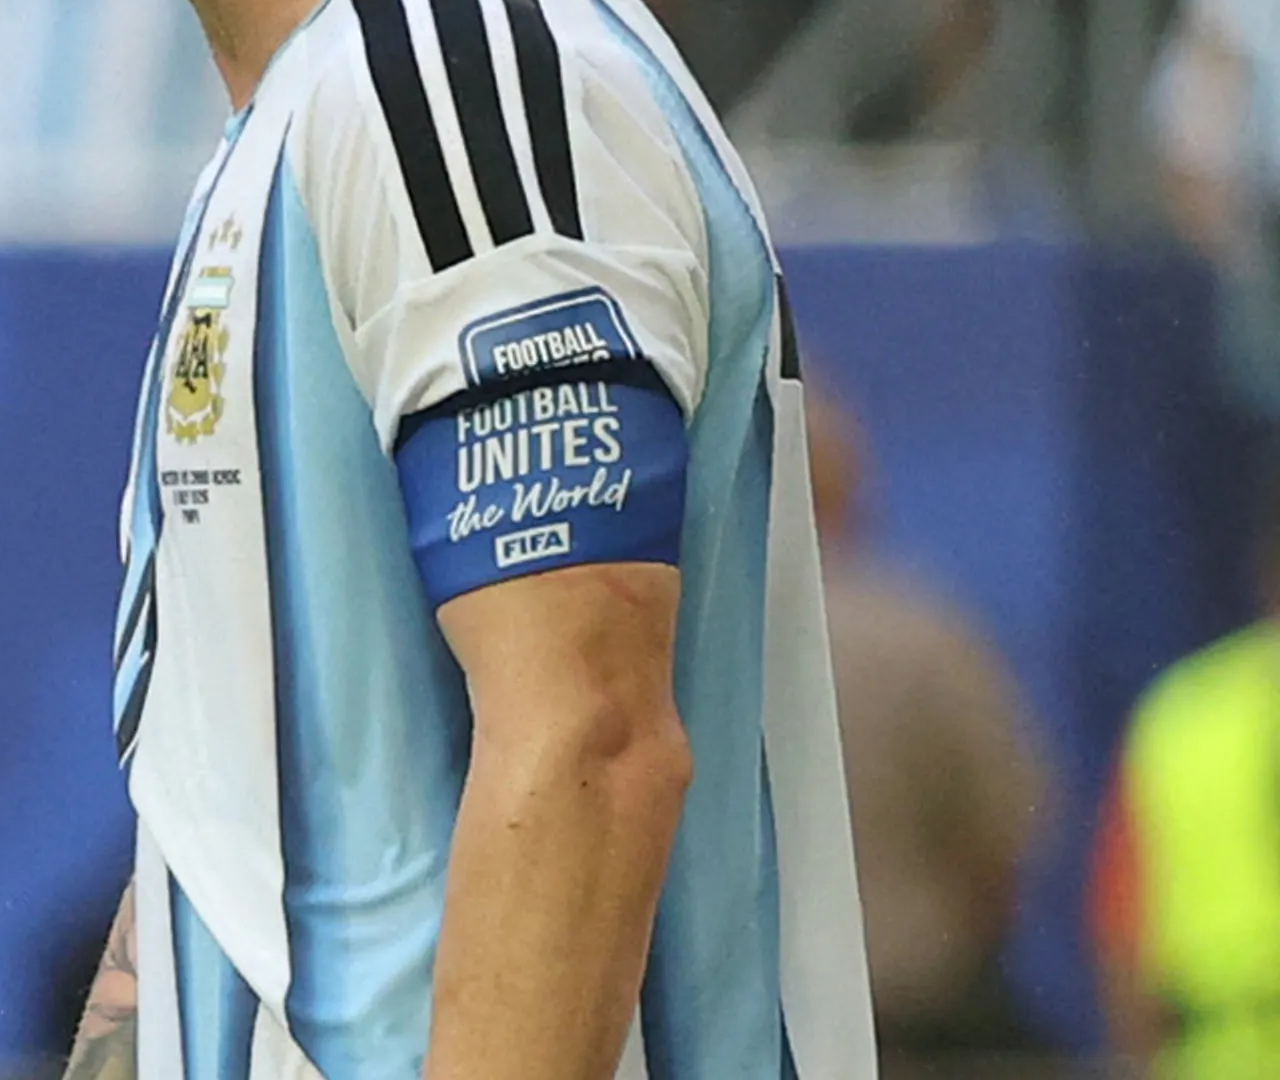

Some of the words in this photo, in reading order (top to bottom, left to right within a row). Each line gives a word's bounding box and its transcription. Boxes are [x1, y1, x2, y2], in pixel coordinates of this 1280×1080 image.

[493, 321, 608, 374] FOOTBALL
[458, 380, 619, 444] FOOTBALL
[458, 415, 622, 493] UNITES
[446, 494, 505, 543] the
[510, 467, 633, 524] World
[503, 530, 564, 560] FIFA
